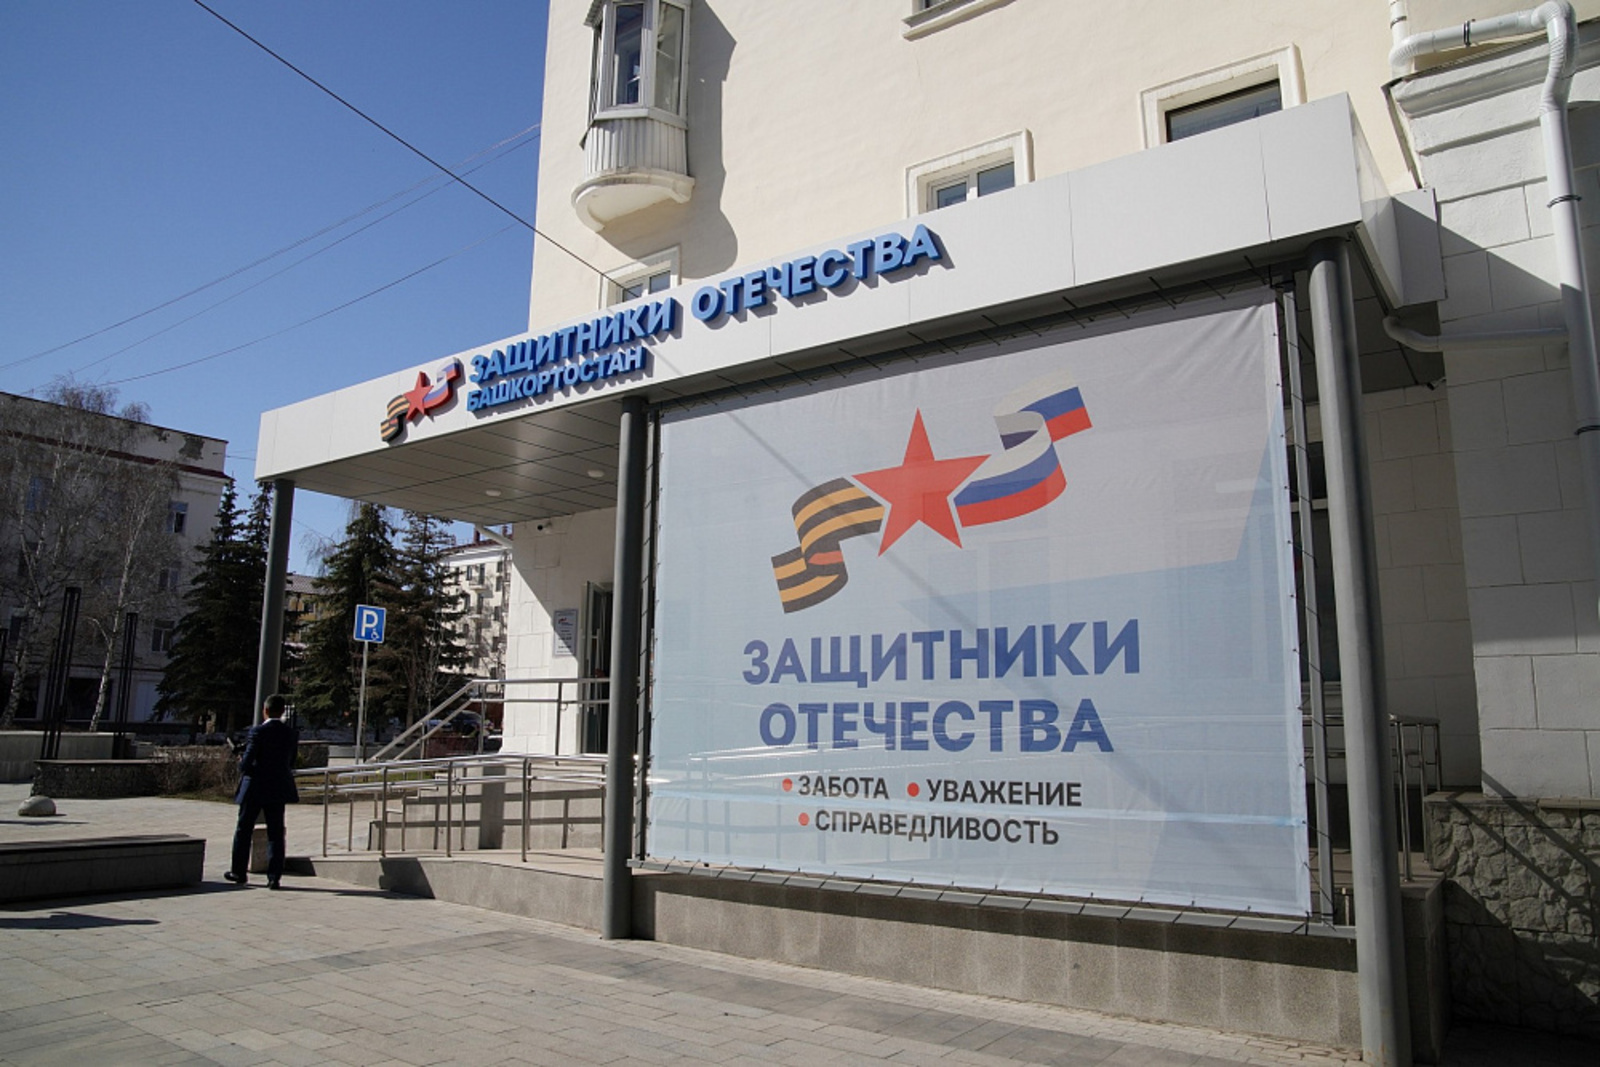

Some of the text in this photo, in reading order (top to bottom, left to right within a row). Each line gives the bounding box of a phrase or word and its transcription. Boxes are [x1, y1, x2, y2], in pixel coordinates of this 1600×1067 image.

[469, 224, 942, 384] ЗАЩИТНИКИ ОТЕЧЕСТВА
[466, 346, 646, 412] БАШКОРТОСТАН
[361, 609, 379, 637] P
[742, 618, 1141, 688] ЗАЩИТНИКИ
[759, 698, 1114, 753] ОТЕЧЕСТВА
[797, 775, 1082, 807] ЗАБОТА УВАЖЕНИЕ
[815, 809, 1060, 846] СПРАВЕДЛИВОСТЬ
